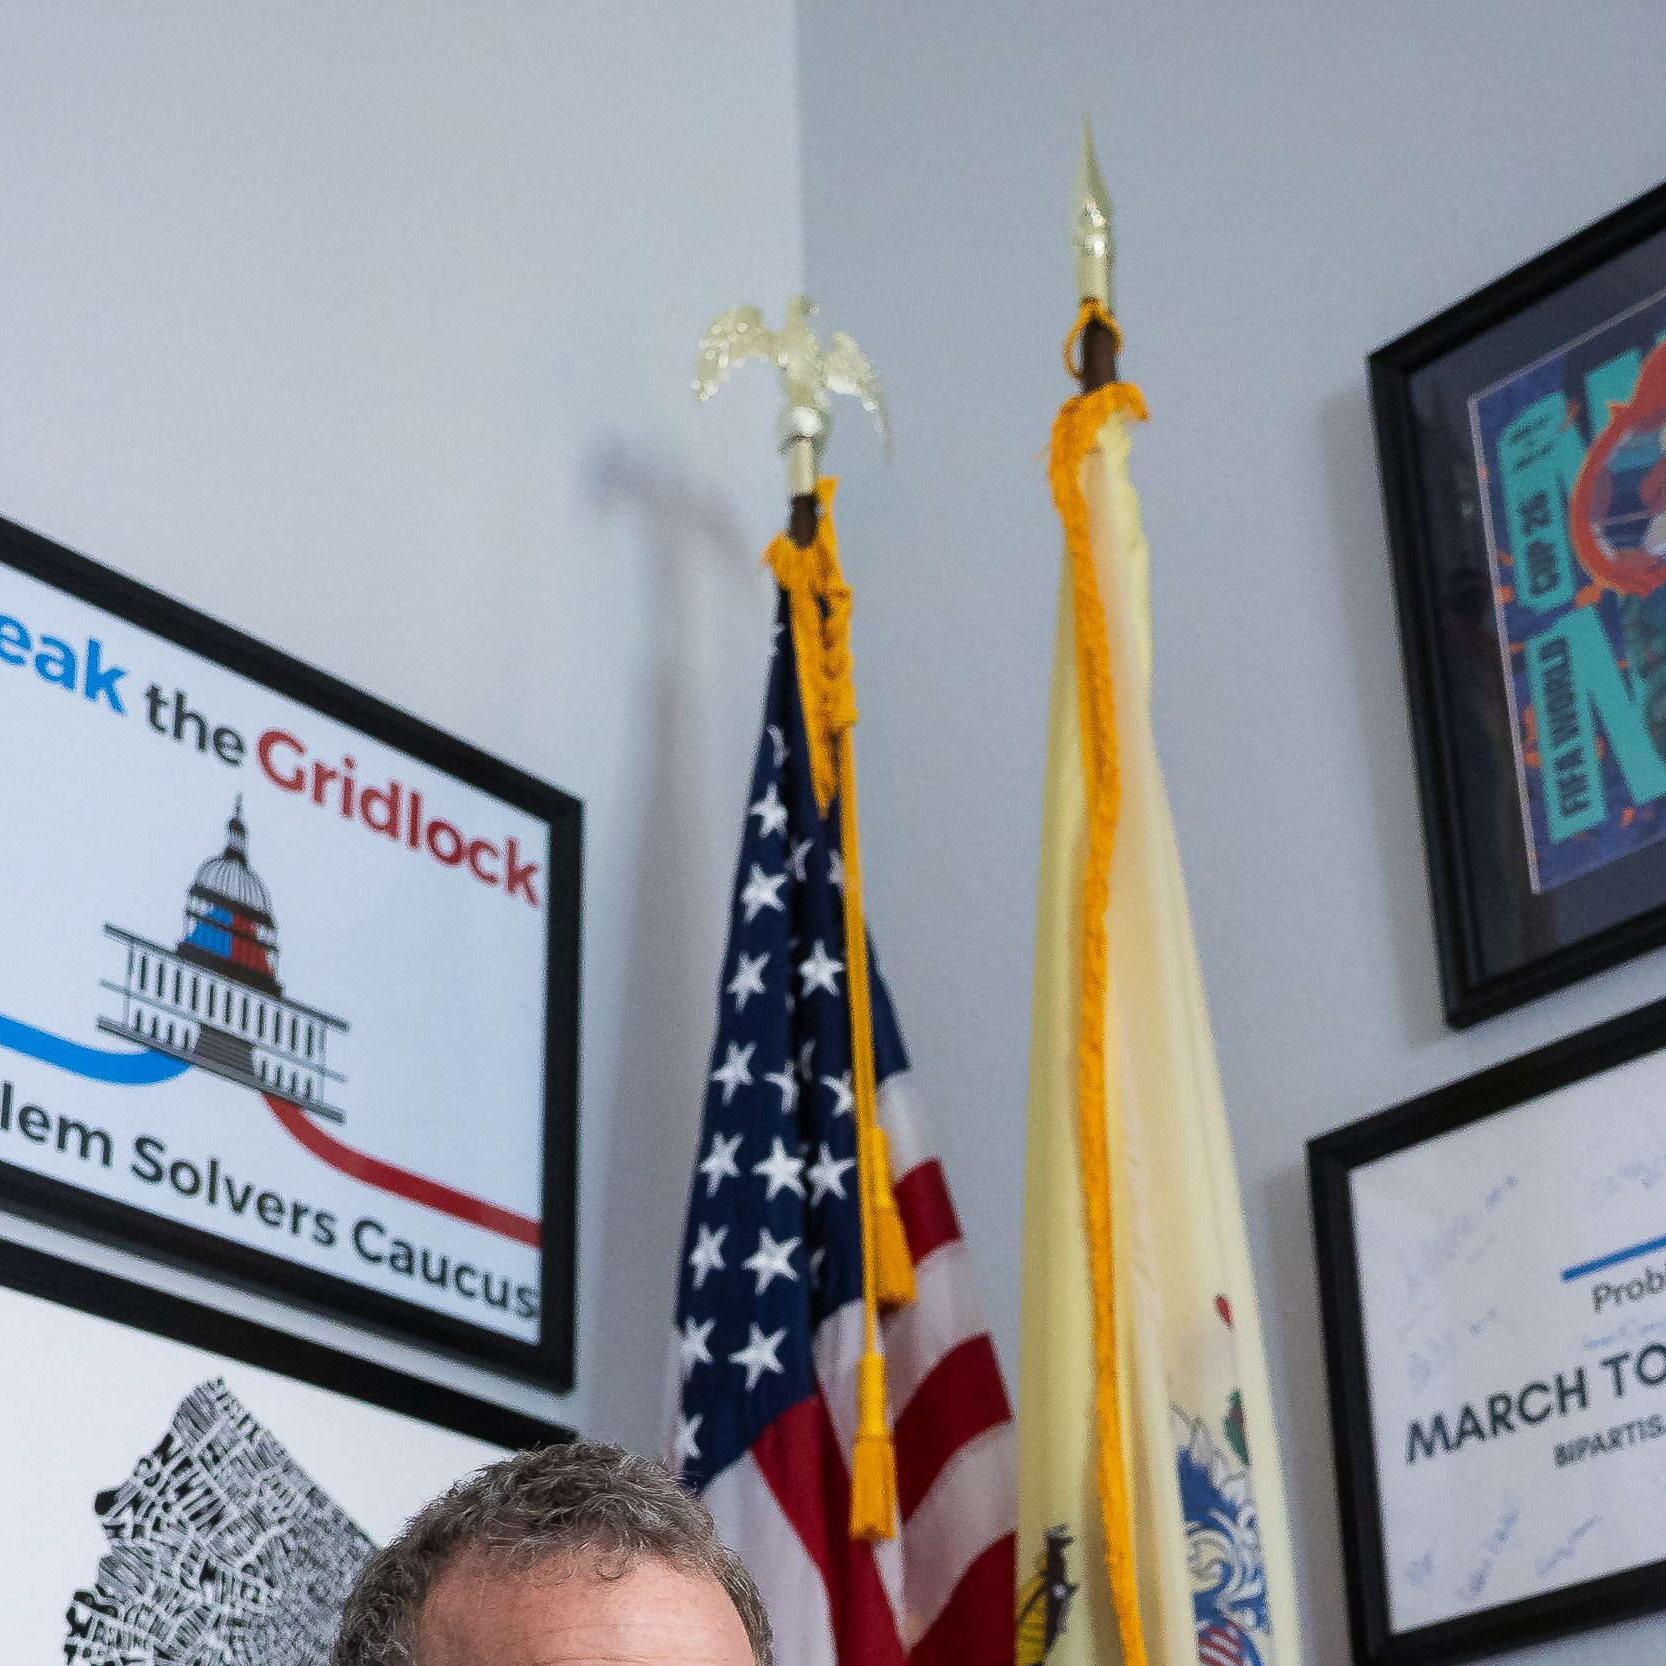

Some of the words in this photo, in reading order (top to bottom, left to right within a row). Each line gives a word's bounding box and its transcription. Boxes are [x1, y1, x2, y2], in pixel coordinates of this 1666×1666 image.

[143, 682, 247, 768] the
[256, 728, 541, 908] Gridlock
[131, 1134, 340, 1251] Solvers
[353, 1217, 537, 1323] Caucus
[1405, 1365, 1592, 1467] MARCH
